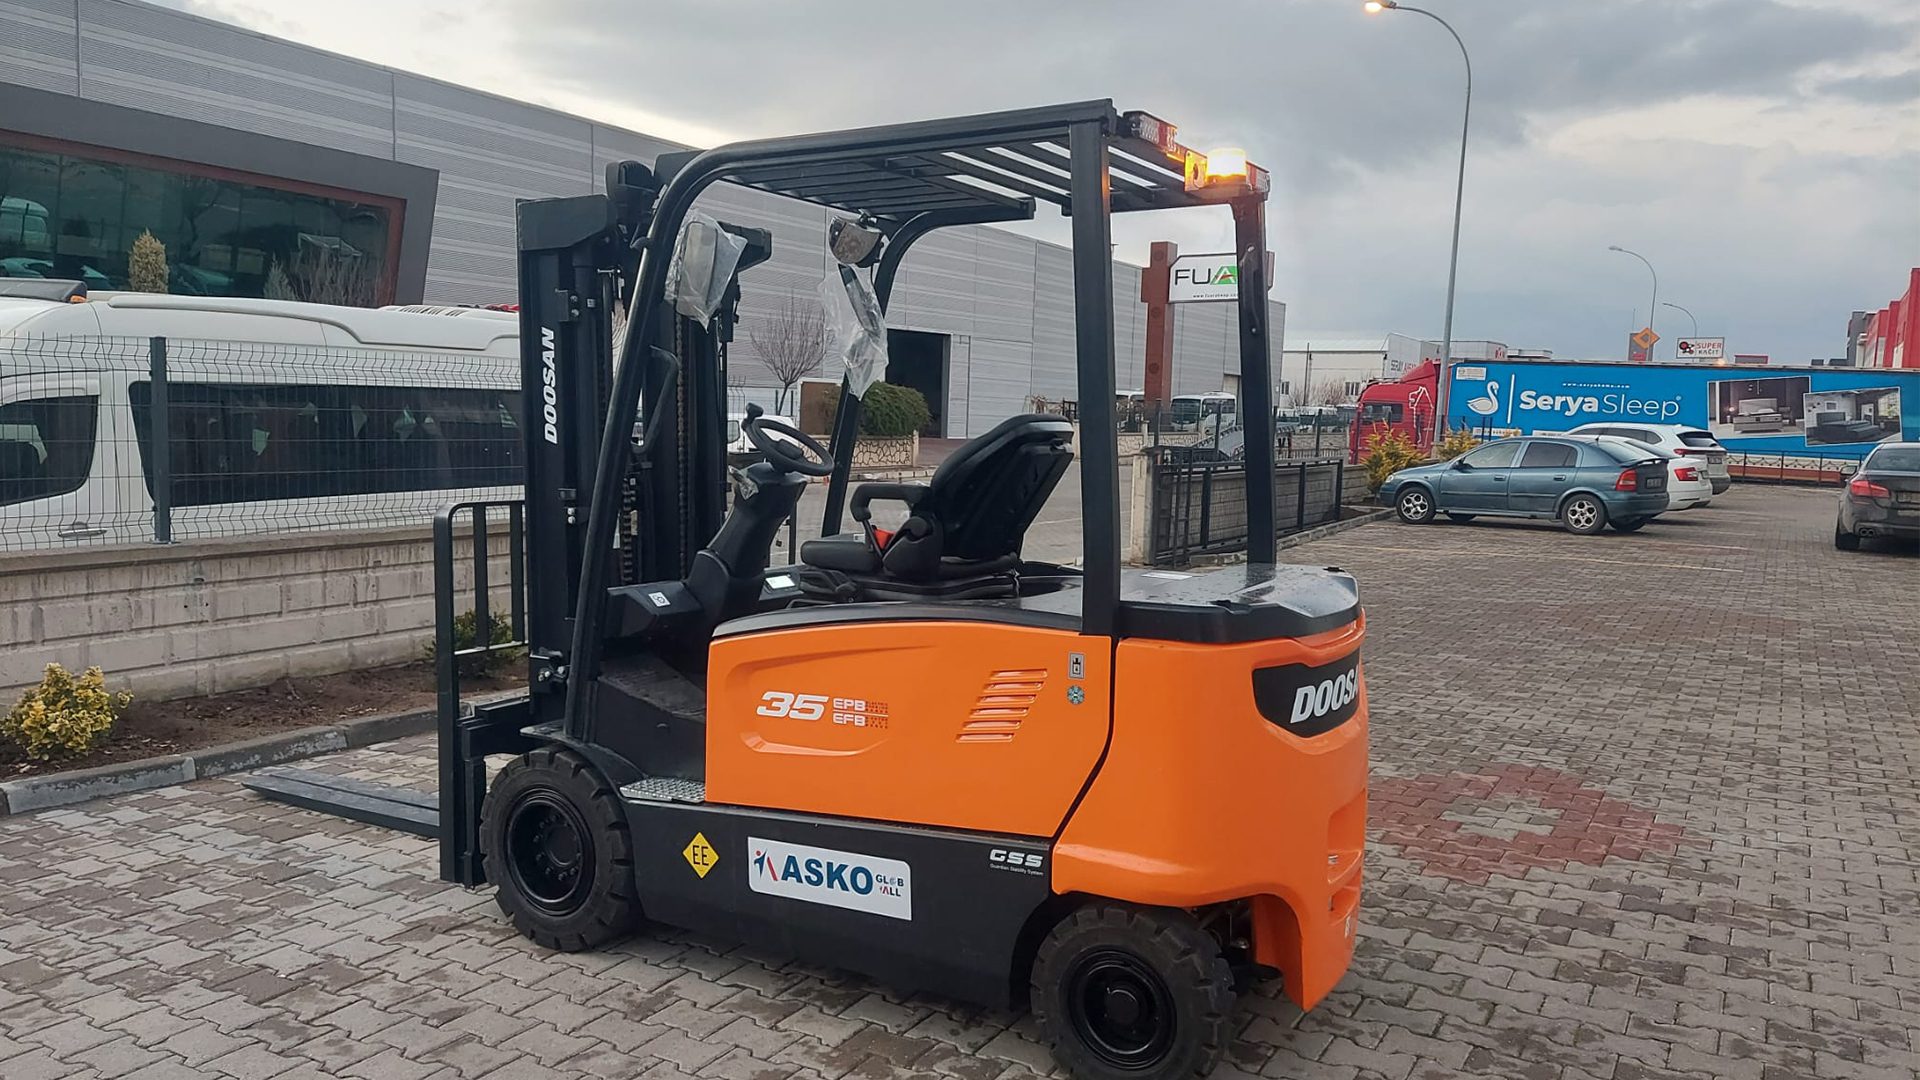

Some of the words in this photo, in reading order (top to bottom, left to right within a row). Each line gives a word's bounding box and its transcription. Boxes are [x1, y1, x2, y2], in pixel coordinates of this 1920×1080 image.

[1696, 342, 1722, 350] SUPER
[541, 326, 558, 444] DOOSAN
[756, 691, 829, 721] 35
[832, 698, 865, 711] EPB
[832, 713, 865, 726] EFB
[693, 845, 709, 866] EE
[990, 849, 1043, 868] GSS
[781, 855, 873, 895] ASKO
